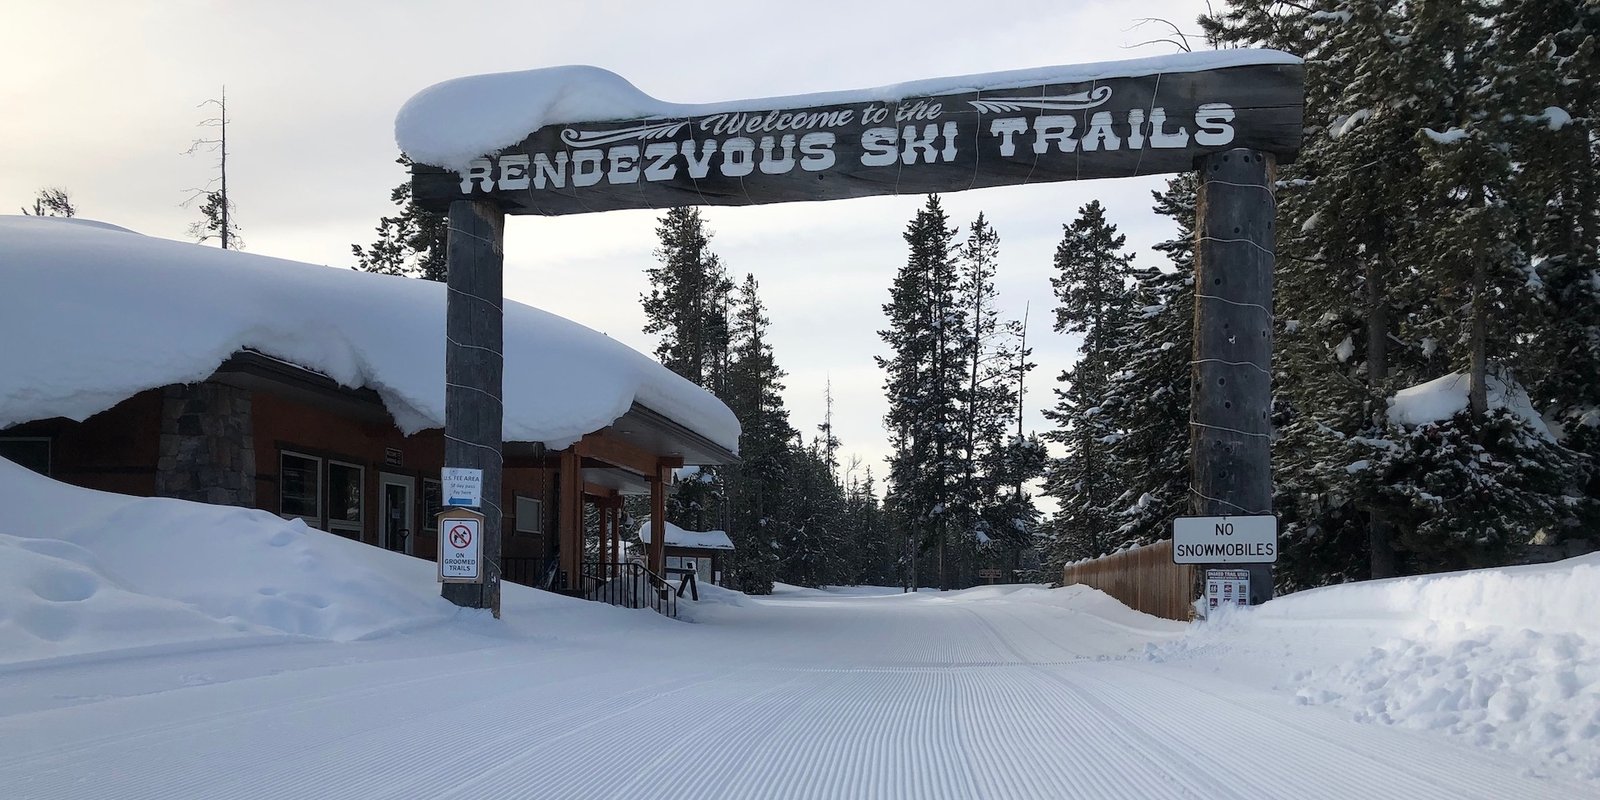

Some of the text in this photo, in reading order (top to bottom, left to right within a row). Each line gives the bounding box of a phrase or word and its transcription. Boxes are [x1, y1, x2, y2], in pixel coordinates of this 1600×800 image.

[699, 99, 943, 135] Welcome to the
[459, 102, 1236, 194] RENDEZVOUS SKI TRAILS
[1215, 522, 1234, 536] NO
[1177, 542, 1274, 557] SNOWMOBILES
